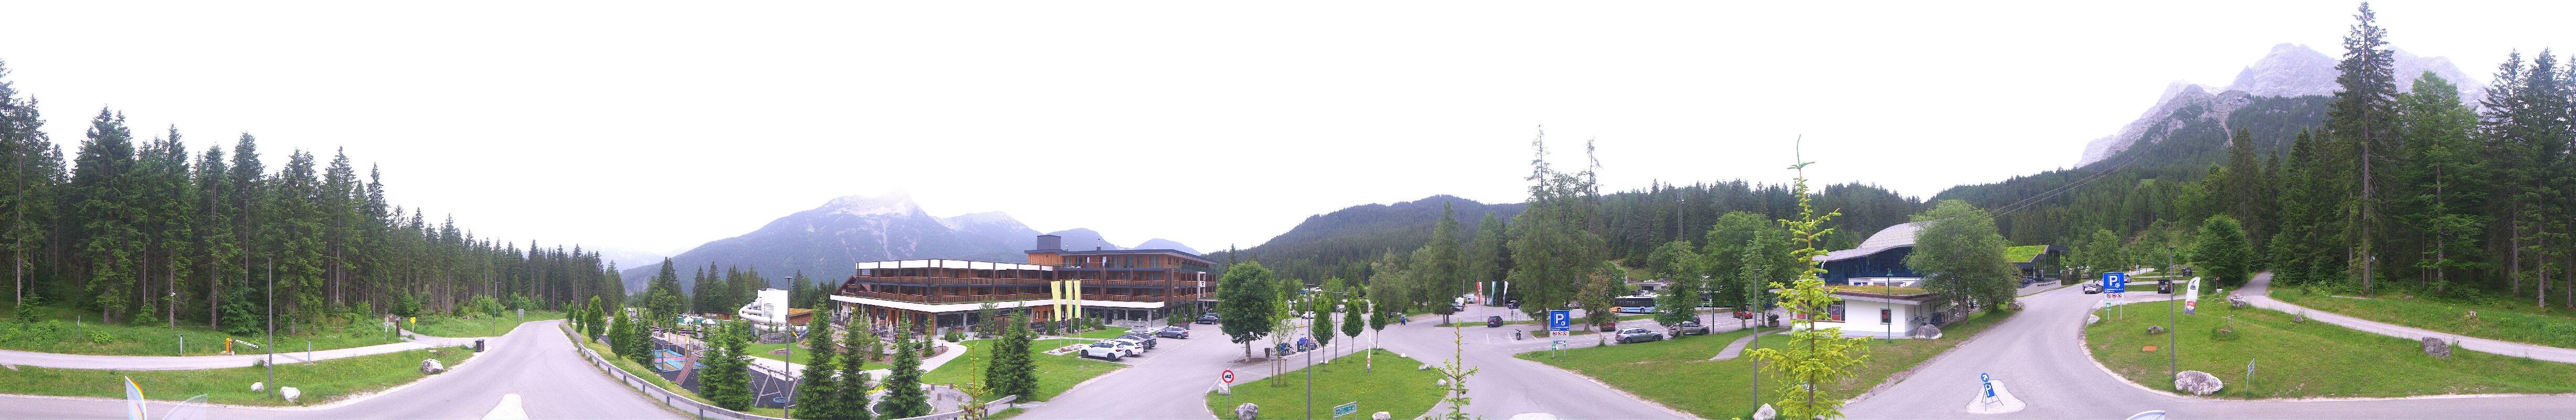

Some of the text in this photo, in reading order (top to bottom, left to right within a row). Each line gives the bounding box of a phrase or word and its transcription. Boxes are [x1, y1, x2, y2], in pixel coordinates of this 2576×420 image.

[2109, 275, 2117, 286] P
[1555, 313, 1564, 324] P
[1985, 384, 1991, 397] P
